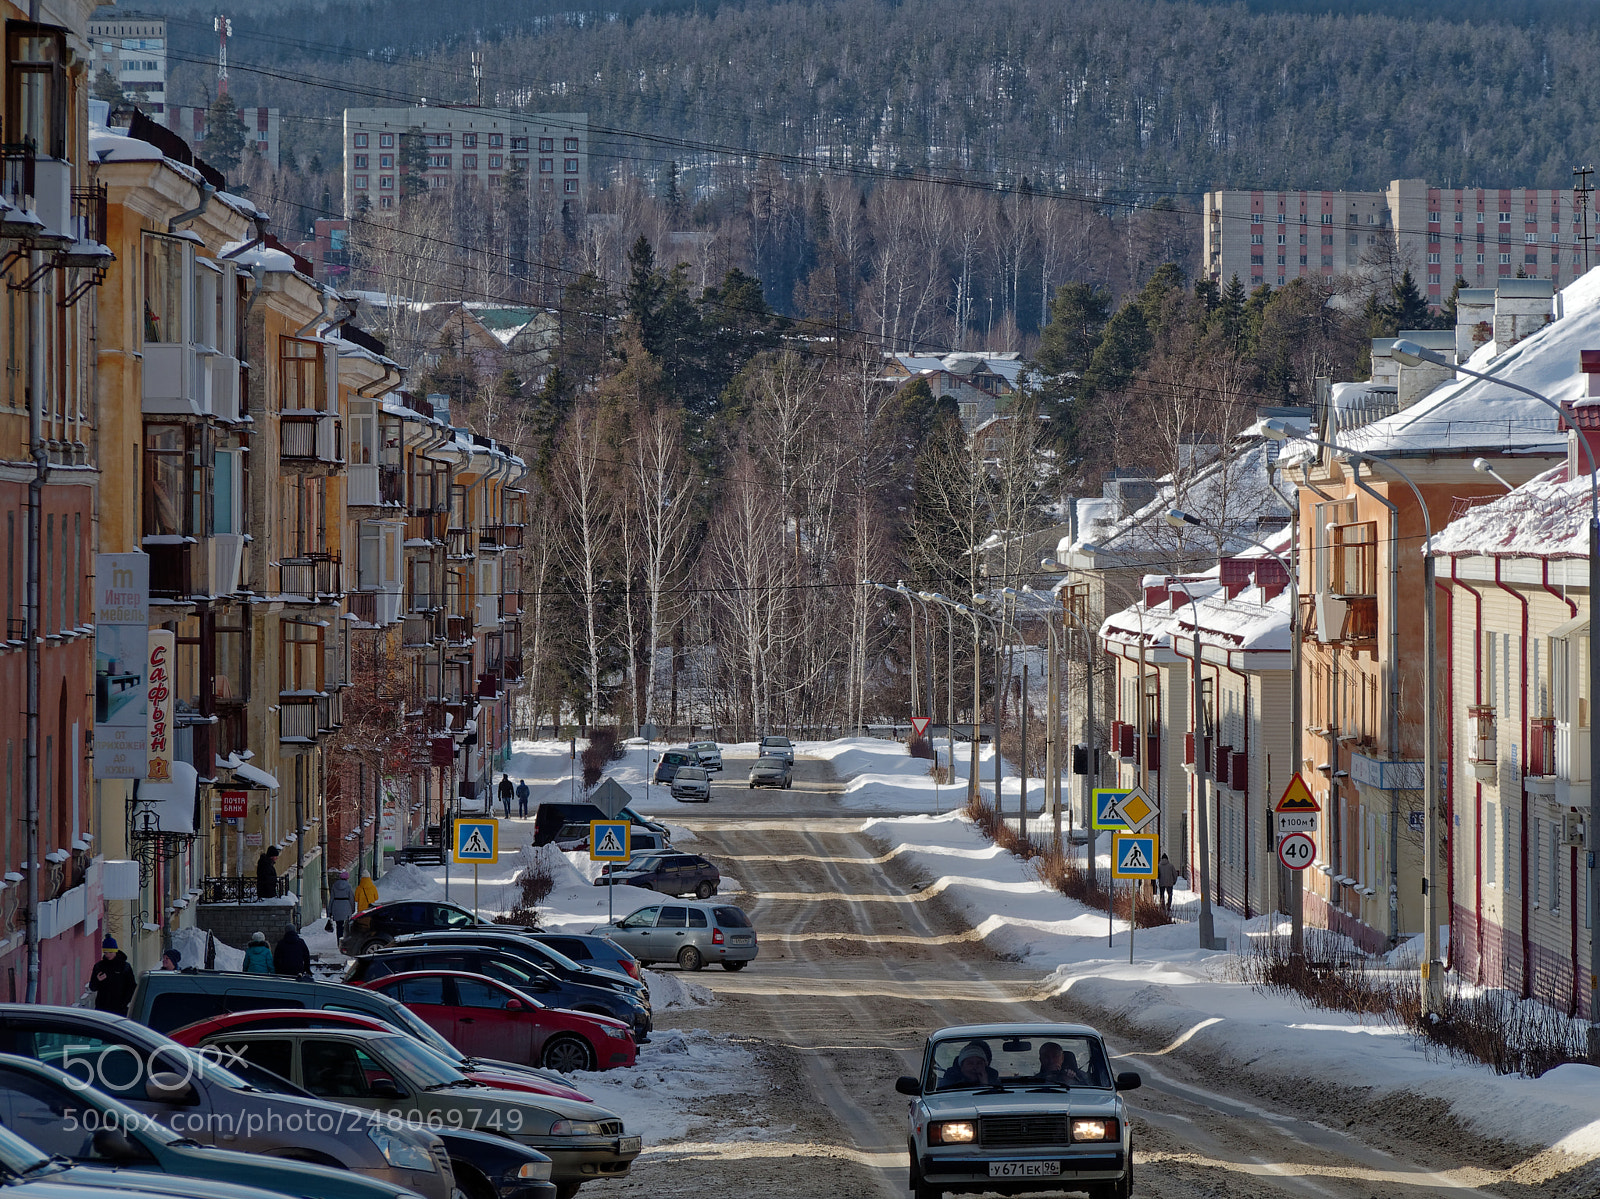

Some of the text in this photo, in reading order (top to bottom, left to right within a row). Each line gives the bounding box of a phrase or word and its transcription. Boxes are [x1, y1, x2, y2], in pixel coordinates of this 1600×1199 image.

[105, 589, 141, 608] Интер
[223, 797, 246, 805] ПОЧТА
[1285, 843, 1309, 858] 40
[1044, 1162, 1056, 1171] 96
